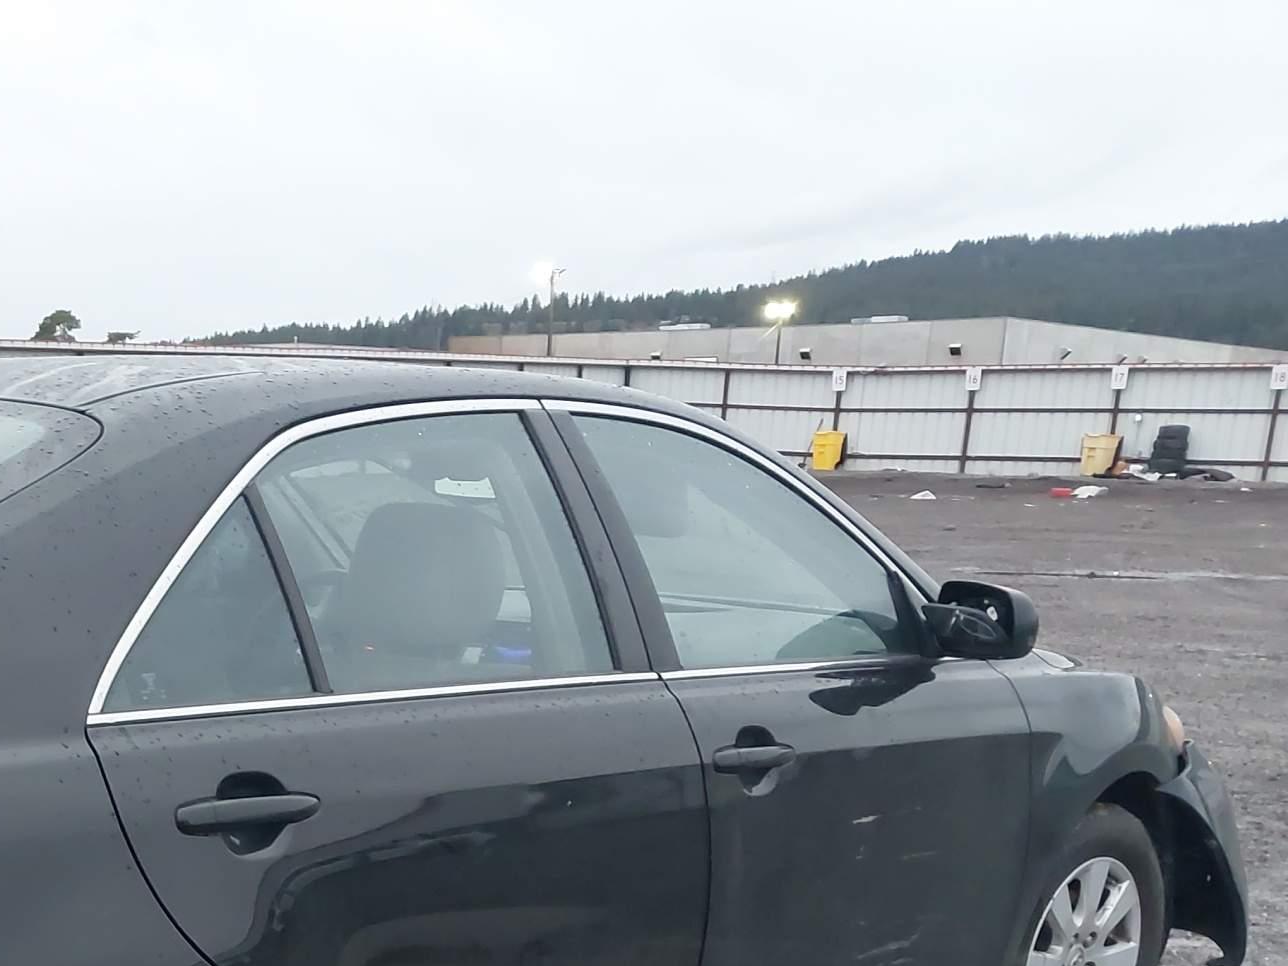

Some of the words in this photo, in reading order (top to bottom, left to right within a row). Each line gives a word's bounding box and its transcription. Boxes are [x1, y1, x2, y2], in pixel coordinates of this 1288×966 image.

[835, 375, 845, 385] 15
[968, 375, 978, 384] 16
[1114, 372, 1125, 382] 17
[1274, 372, 1286, 382] 18
